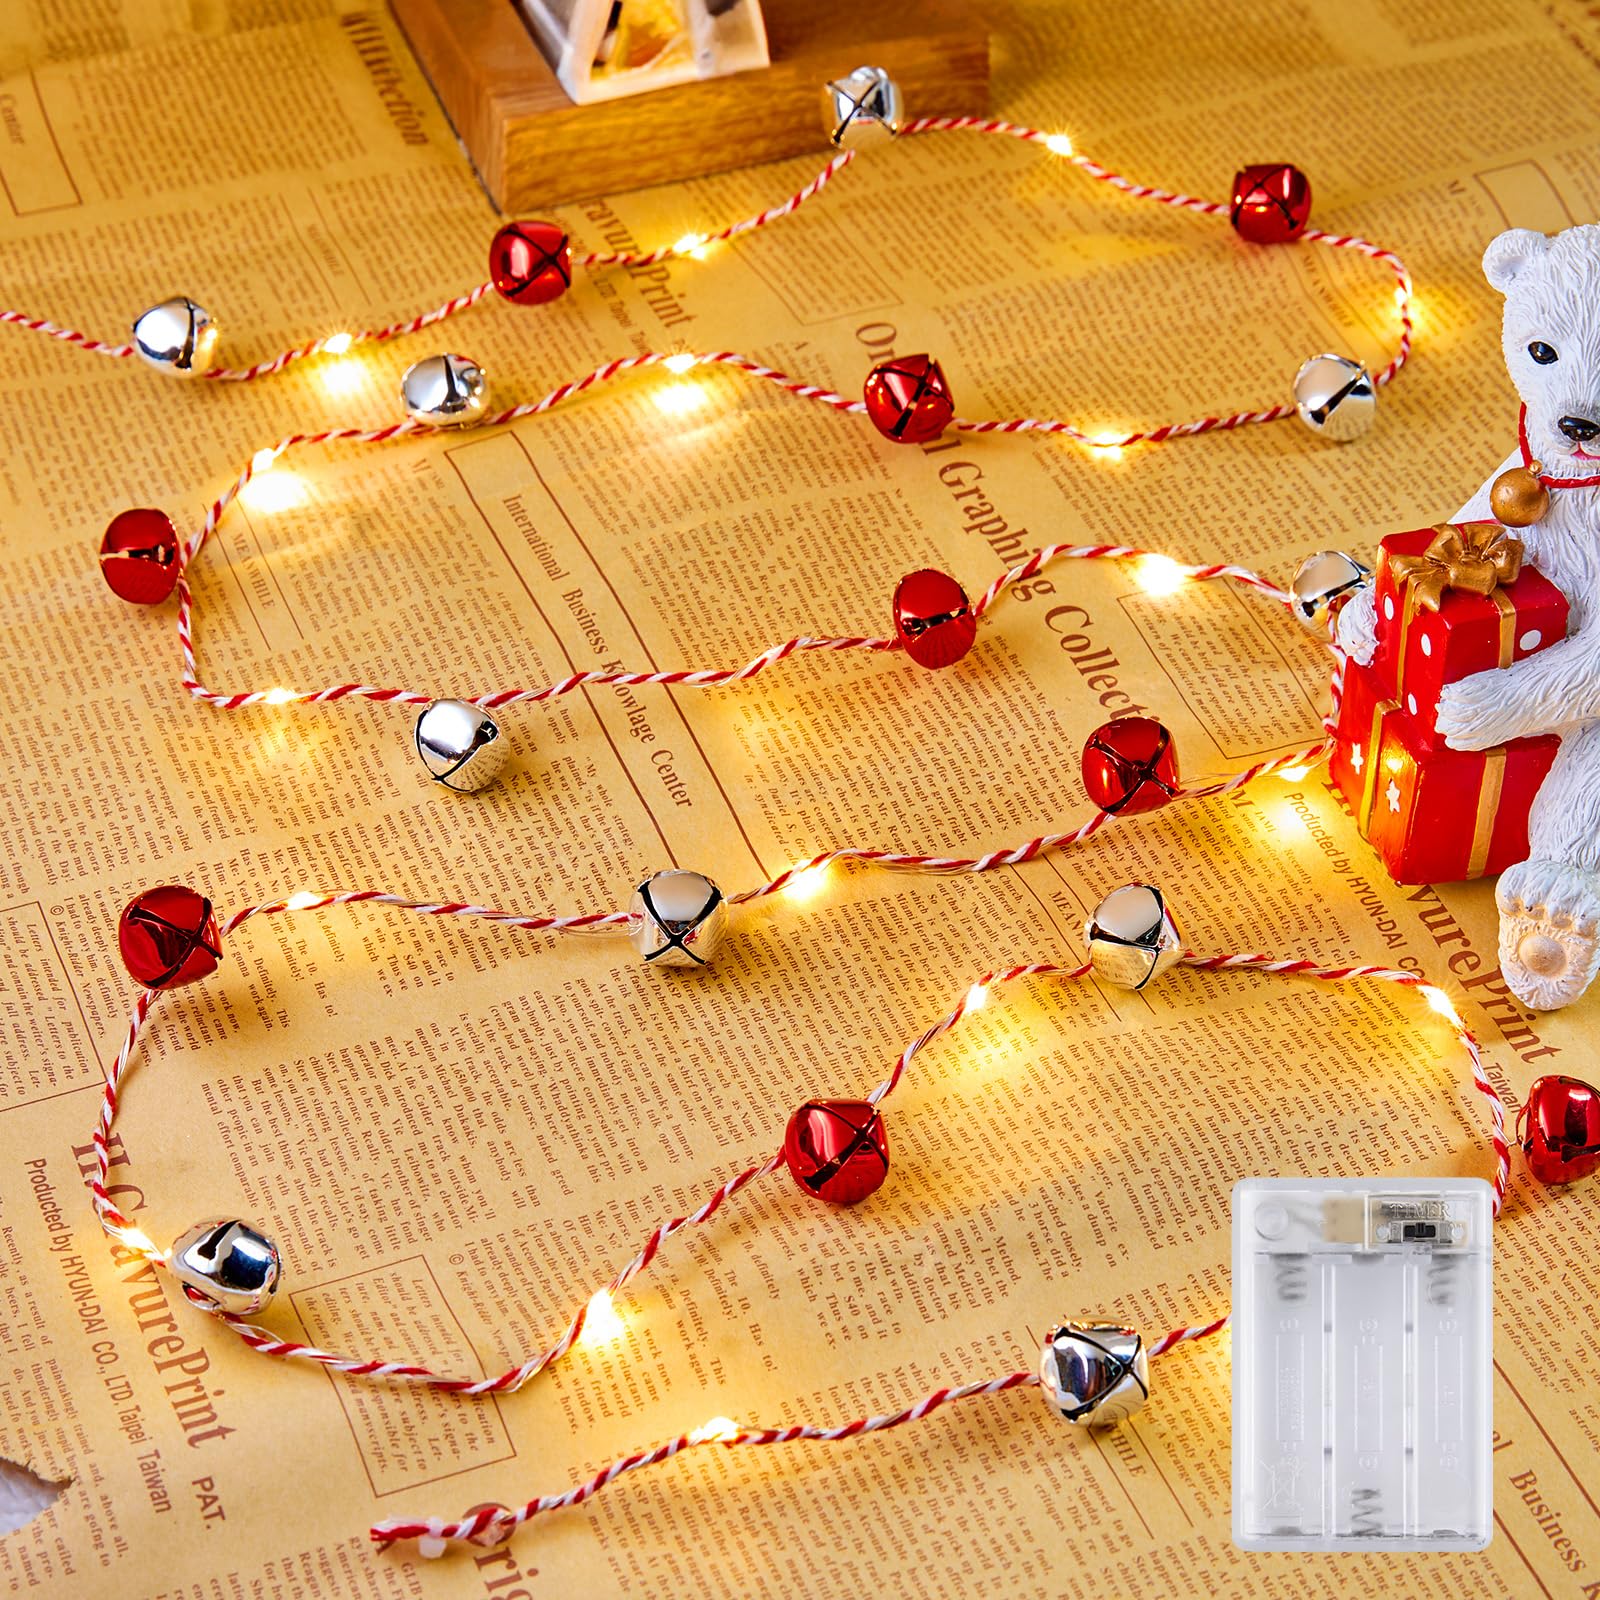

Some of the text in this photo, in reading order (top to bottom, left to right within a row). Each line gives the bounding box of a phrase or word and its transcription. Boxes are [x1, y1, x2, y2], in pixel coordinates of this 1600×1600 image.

[230, 532, 276, 610] MEANWHILE
[502, 493, 571, 582] International
[561, 587, 609, 655] Business
[650, 749, 693, 807] Center
[1044, 604, 1149, 725] Collect
[886, 670, 914, 701] greatest
[911, 704, 939, 738] scientific
[936, 740, 953, 756] and
[947, 757, 973, 796] military
[902, 666, 922, 690] House
[922, 699, 955, 738] governing
[951, 738, 973, 765] center
[975, 780, 988, 795] the
[985, 797, 1010, 831] world's
[921, 671, 935, 686] The
[931, 686, 959, 720] spectacle
[961, 730, 990, 769] astrology
[992, 783, 1006, 798] the
[1003, 798, 1023, 826] White
[941, 677, 1040, 823] crackpot pseudoscience for others?
[558, 775, 572, 792] way
[579, 814, 597, 840] that's
[595, 783, 613, 808] whole
[588, 861, 613, 897] watched
[1200, 825, 1287, 948] employ time-management
[1233, 849, 1259, 879] caught
[1283, 791, 1346, 858] Producted
[1331, 858, 1356, 874] by
[1345, 876, 1409, 950] HYUN-DAI
[880, 896, 911, 936] definitely
[909, 942, 923, 956] the
[918, 957, 936, 976] best
[927, 976, 946, 992] job
[893, 892, 963, 993] Miami Herald's racing
[909, 889, 929, 915] which
[932, 931, 965, 969] probably
[1236, 903, 1270, 947] efficiency
[1276, 887, 1310, 933] Realizing
[1307, 937, 1325, 959] that
[414, 1027, 438, 1063] mention
[338, 1047, 361, 1082] happens
[369, 1110, 382, 1127] the
[377, 1128, 395, 1155] older
[390, 1157, 413, 1197] brother
[413, 1211, 434, 1242] singer
[402, 1040, 477, 1184] And you never know whom
[404, 1075, 417, 1090] the
[413, 1093, 435, 1127] Calder
[431, 1134, 452, 1163] track
[446, 1168, 470, 1206] outside
[429, 1022, 443, 1038] one
[471, 1107, 489, 1129] that
[486, 1140, 512, 1182] anybody
[511, 1190, 527, 1209] will
[454, 1037, 467, 1053] the
[480, 1090, 494, 1107] the
[490, 1111, 507, 1135] odds
[512, 1157, 527, 1178] less
[524, 1184, 541, 1208] than
[1179, 1191, 1199, 1218] such
[1389, 1201, 1451, 1220] TIMER
[390, 1272, 413, 1302] should
[1510, 1215, 1585, 1302] anticipating Nancy
[1535, 1269, 1551, 1286] the
[1567, 1236, 1593, 1264] topics
[411, 1278, 433, 1309] Letters
[723, 1269, 738, 1287] The
[748, 1322, 765, 1347] Has
[23, 1157, 72, 1233] Producted
[48, 1232, 75, 1253] by
[62, 1254, 109, 1335] HYUN-DAI
[117, 1404, 154, 1445] Taipei
[136, 1448, 173, 1514] Taiwan
[191, 1475, 227, 1531] PAT.
[1536, 1347, 1560, 1373] signs
[367, 1383, 401, 1449] responsible
[399, 1410, 423, 1455] subject
[1508, 1470, 1586, 1573] Business
